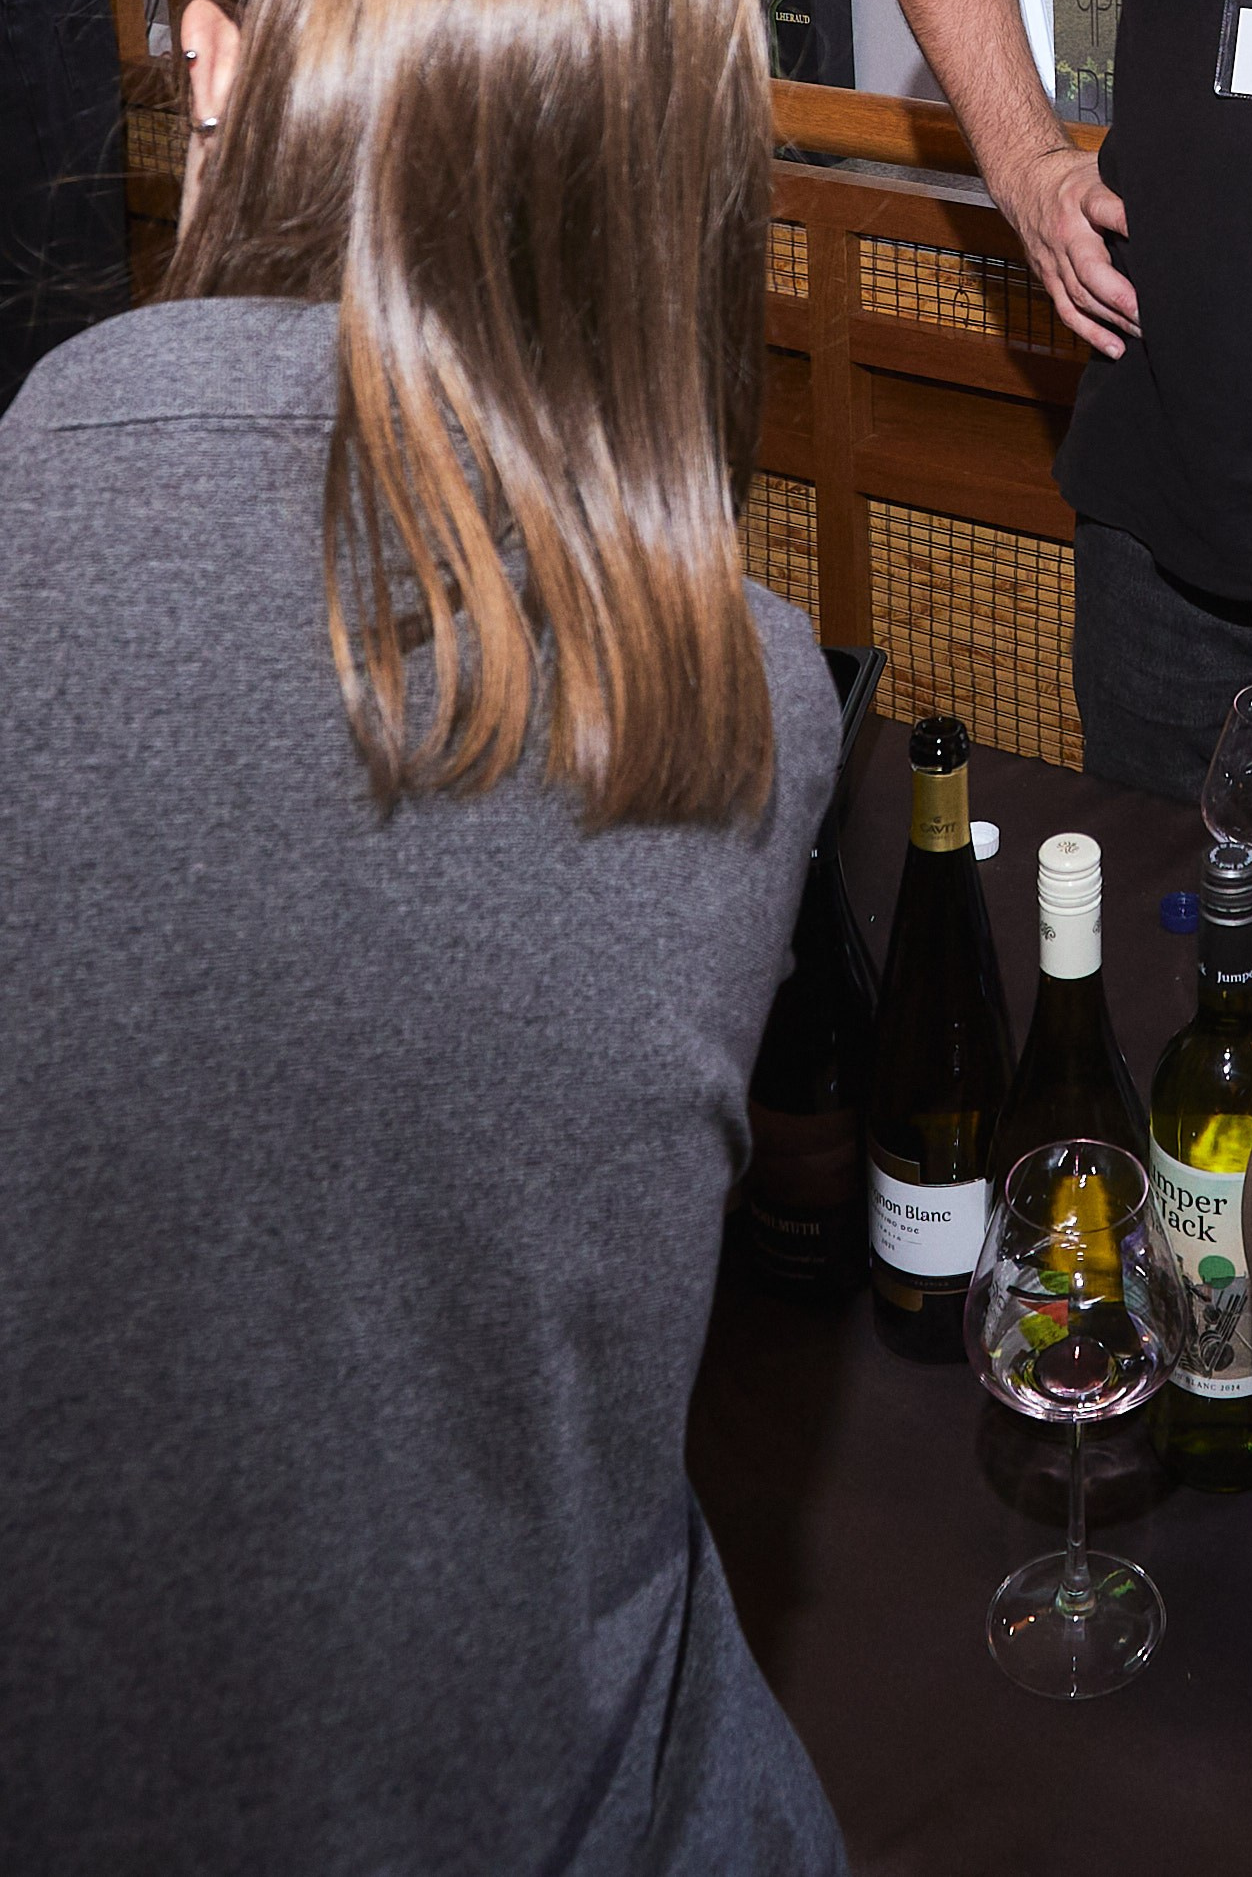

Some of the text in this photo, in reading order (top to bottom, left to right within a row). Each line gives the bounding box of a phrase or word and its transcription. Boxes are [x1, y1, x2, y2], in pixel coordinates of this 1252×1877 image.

[775, 11, 811, 24] LHERAUD
[906, 1204, 951, 1223] Blanc
[900, 1225, 919, 1234] DOC
